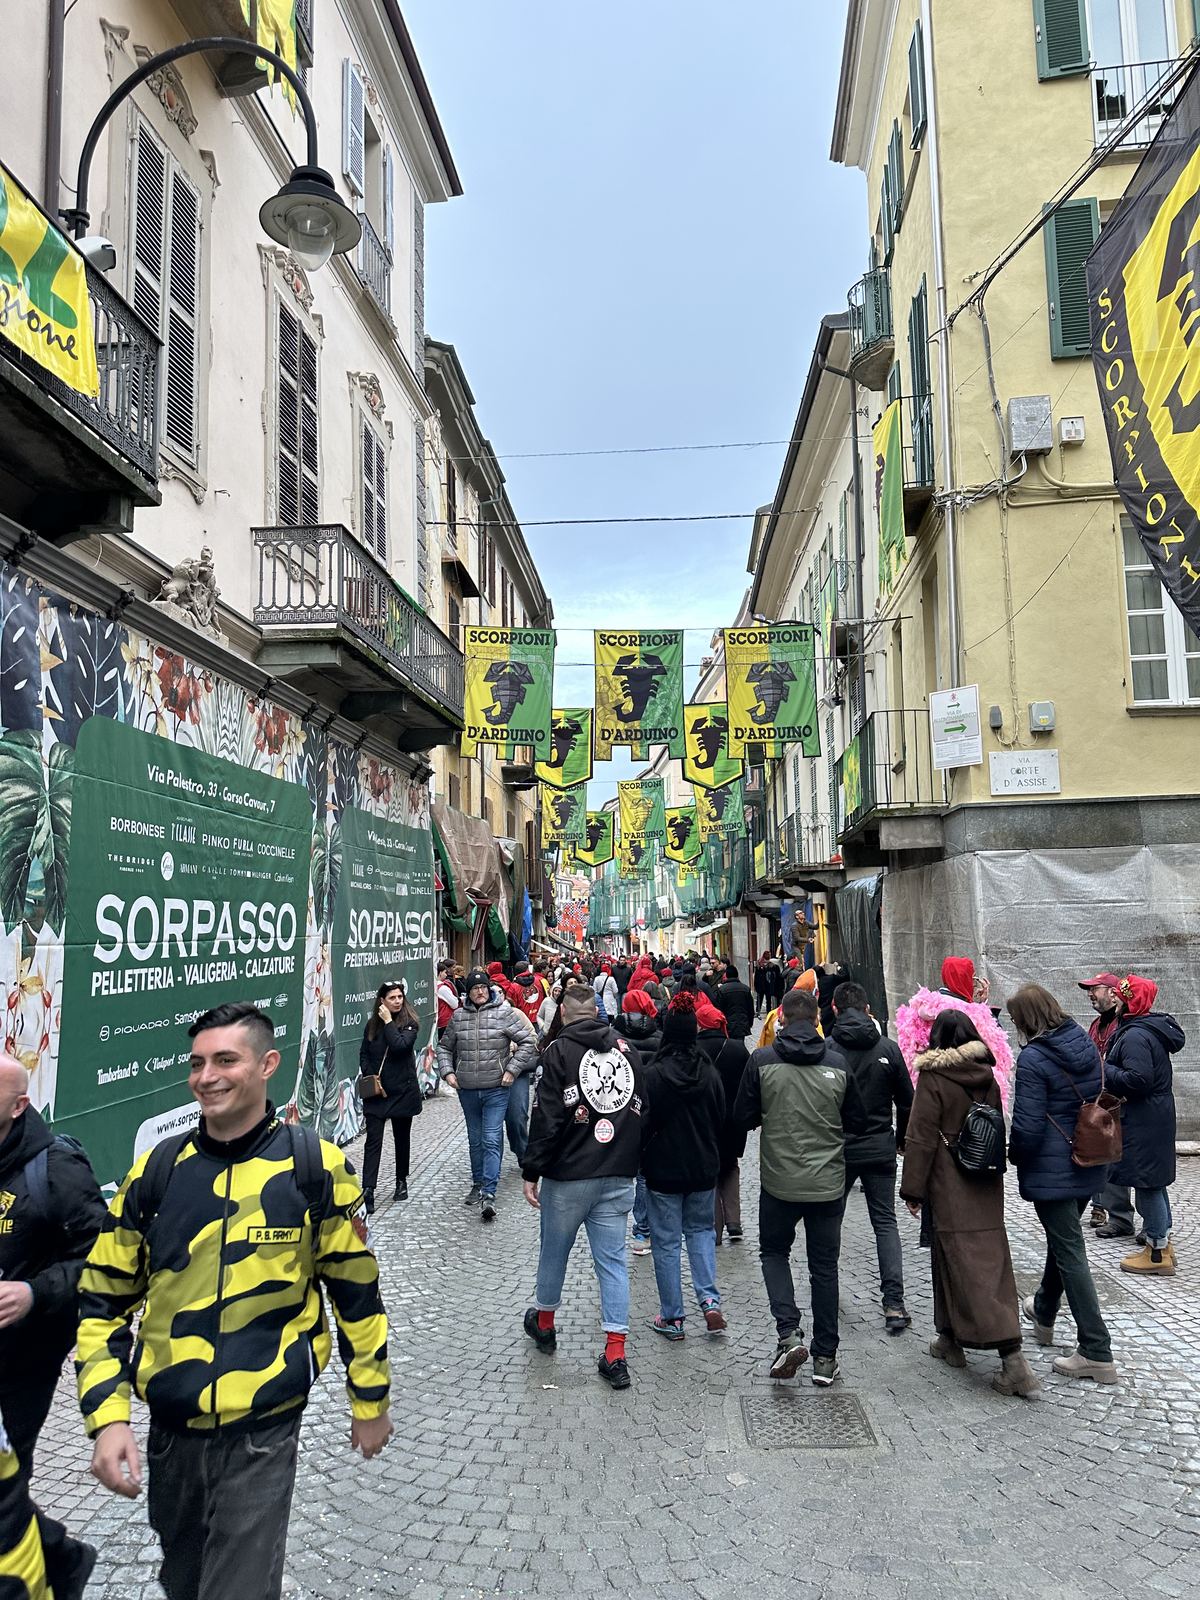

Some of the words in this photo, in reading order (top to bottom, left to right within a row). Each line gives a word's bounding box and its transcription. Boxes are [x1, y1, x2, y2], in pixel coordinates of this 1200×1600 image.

[469, 630, 550, 646] SCORPIONI
[599, 633, 679, 647] SCORPIONI
[728, 629, 809, 645] SCORPIONI
[467, 725, 545, 742] D'ARDUINO
[601, 726, 678, 742] D'ARDUINO
[734, 724, 813, 740] D'ARDUINO
[1010, 766, 1039, 776] CORTE
[147, 763, 165, 784] Via
[166, 769, 206, 797] Palestro,
[207, 781, 218, 798] 33
[222, 786, 243, 806] Corso
[270, 799, 276, 813] 7
[620, 780, 662, 790] SCORPIONI
[1017, 778, 1047, 787] ASSISE
[110, 816, 166, 839] BORBONESE
[623, 830, 664, 840] D'ARDUINO
[701, 822, 742, 833] D'ARDUINO
[202, 833, 231, 850] PINKO
[233, 837, 254, 853] FURLA
[108, 853, 123, 863] THE
[126, 855, 155, 866] BRIDGE
[257, 843, 296, 860] COCCINELLE
[93, 893, 297, 964] SORPASSO
[91, 966, 174, 997] PELLETTERIA
[184, 961, 238, 986] VALIGERIA
[245, 956, 296, 978] CALZATURE
[113, 1018, 170, 1036] PIQUADRO
[97, 1062, 132, 1085] Timberland
[272, 1229, 294, 1241] ARMY
